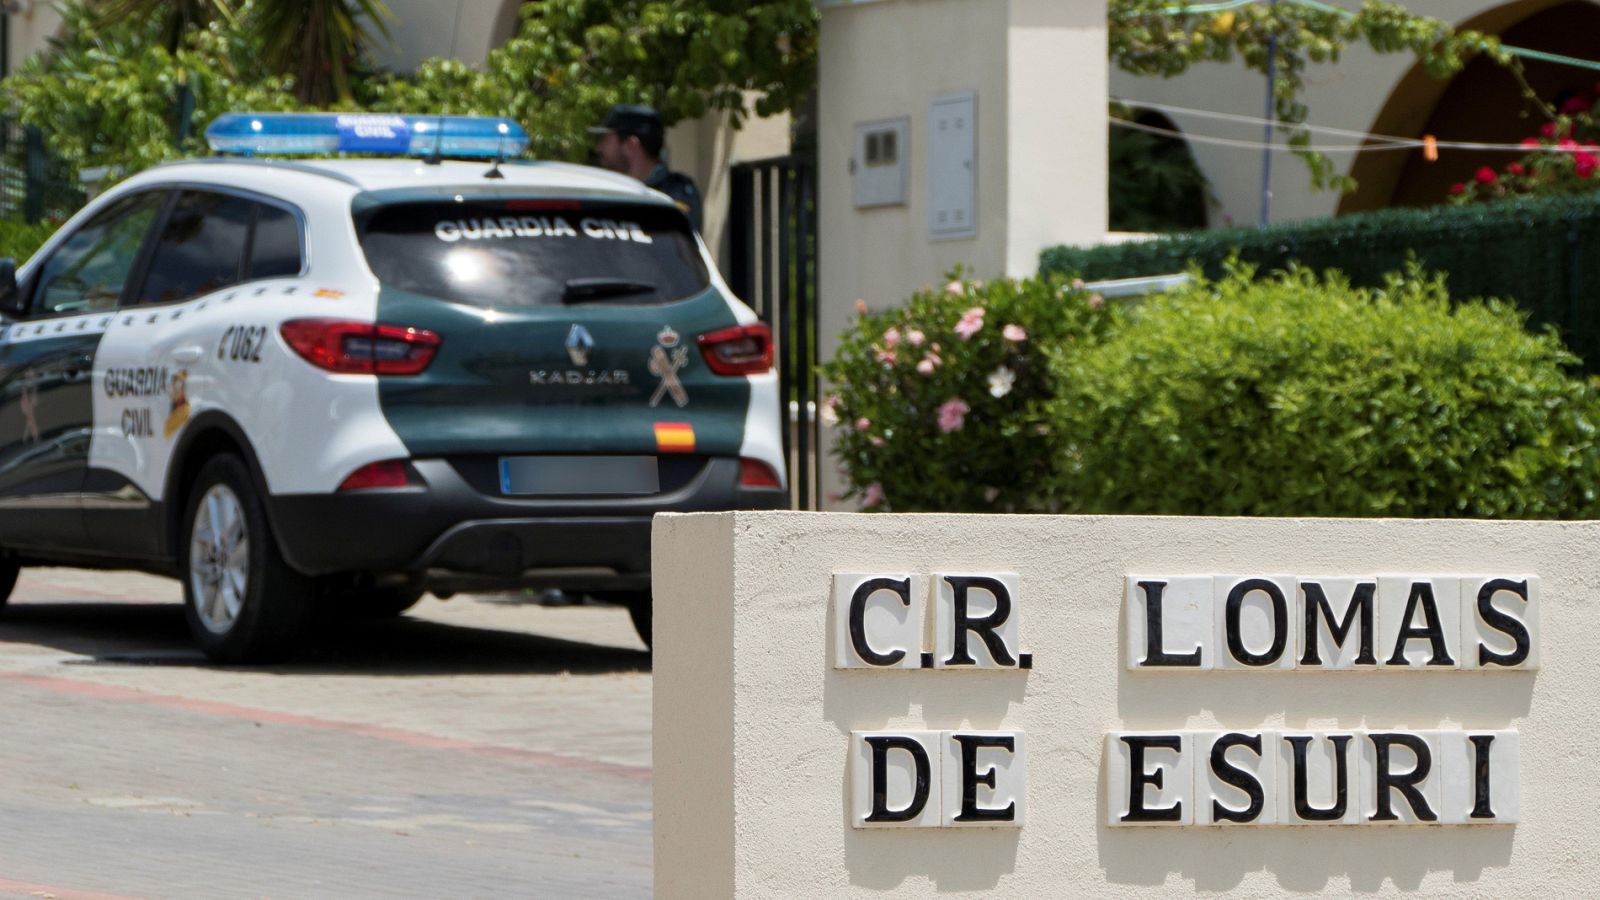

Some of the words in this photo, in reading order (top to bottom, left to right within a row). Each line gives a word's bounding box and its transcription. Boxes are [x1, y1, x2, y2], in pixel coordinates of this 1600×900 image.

[434, 215, 578, 242] GUARDIA
[580, 216, 653, 245] CIVIL
[103, 366, 168, 397] GUARDIA
[529, 369, 630, 385] KADJAR
[121, 407, 155, 438] CIVIL
[849, 576, 1033, 669] C.R.
[1137, 578, 1530, 667] LOMAS
[864, 734, 1015, 823] DE
[1120, 733, 1495, 823] ESURI
